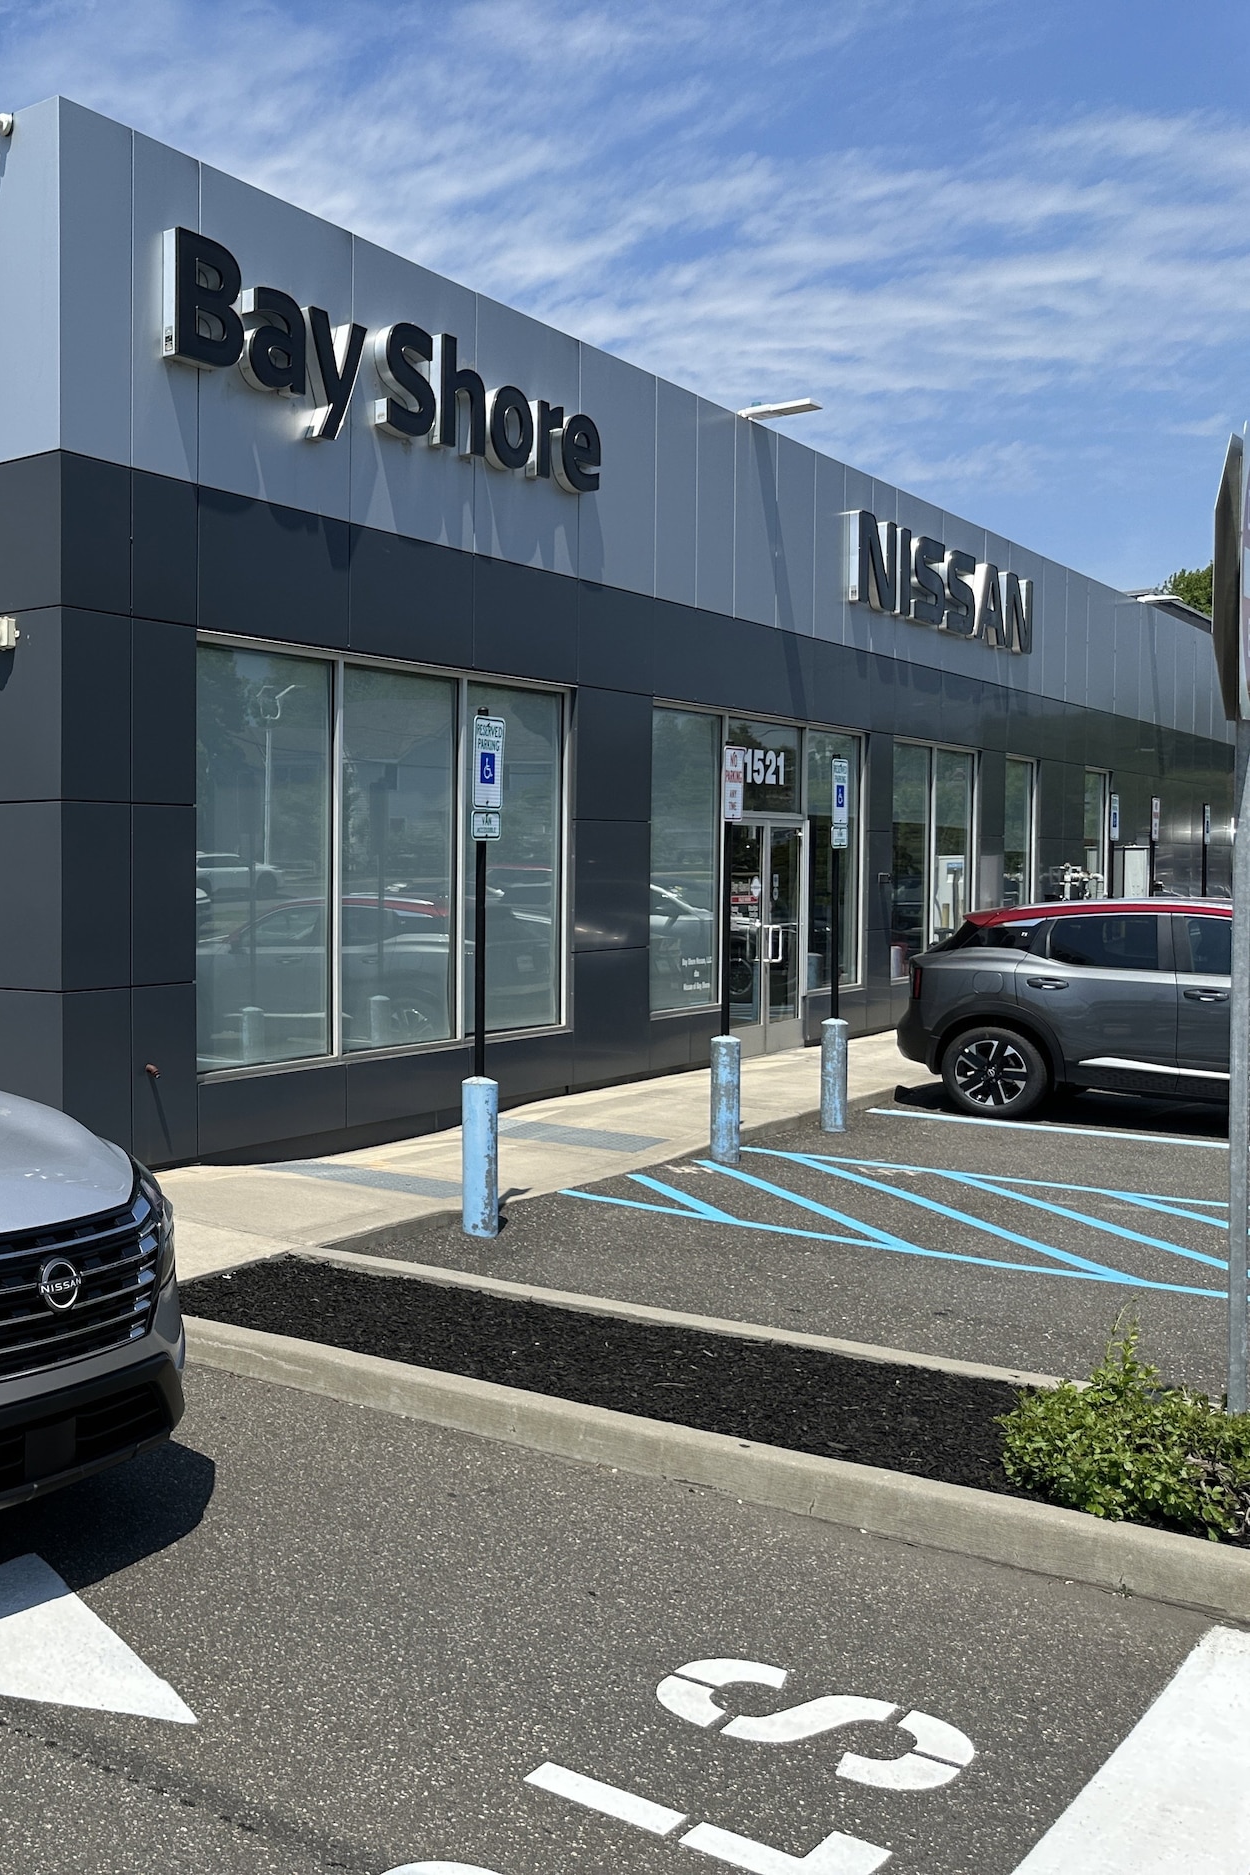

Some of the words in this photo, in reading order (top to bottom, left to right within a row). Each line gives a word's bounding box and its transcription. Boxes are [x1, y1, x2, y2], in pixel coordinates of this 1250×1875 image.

[164, 226, 367, 441] Bay
[375, 322, 602, 494] Shore
[849, 510, 1034, 655] NISSAN
[477, 723, 503, 738] RESERVED
[477, 738, 500, 752] PARKING
[730, 753, 738, 767] NO
[744, 748, 785, 785] 1521
[725, 770, 743, 783] PARKING
[481, 816, 492, 826] VAN
[40, 1277, 82, 1293] NISSAN
